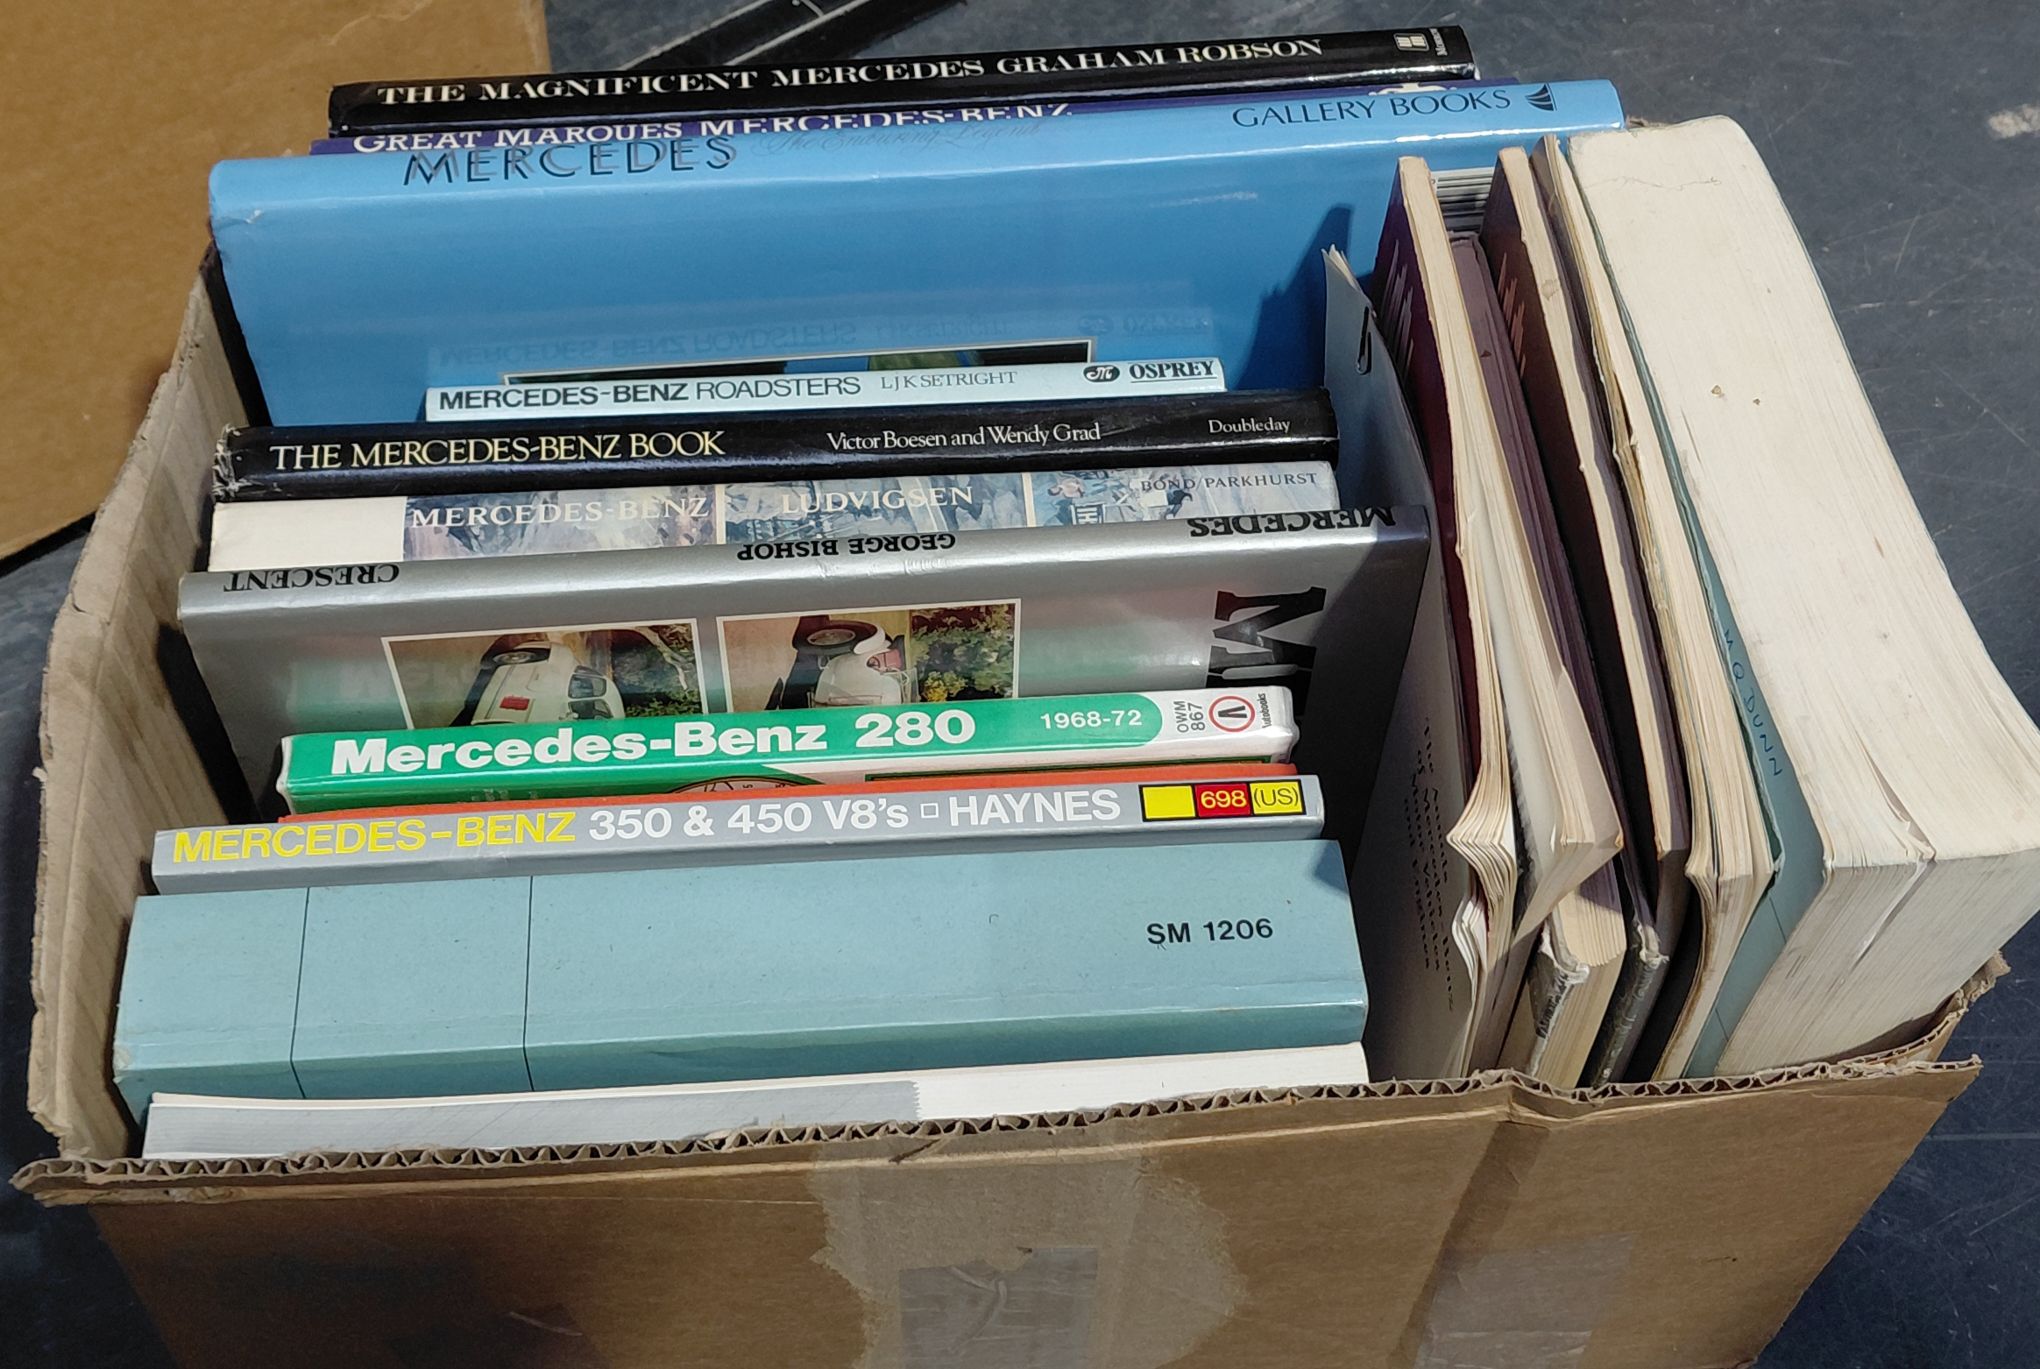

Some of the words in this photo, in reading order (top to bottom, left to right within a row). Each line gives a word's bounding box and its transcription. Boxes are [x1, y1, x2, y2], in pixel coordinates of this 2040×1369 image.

[377, 83, 466, 105] THE
[478, 70, 758, 100] MAGNIFICENT
[770, 58, 985, 88] MERCEDES
[996, 47, 1168, 75] GRAHAM
[1176, 38, 1325, 63] ROBSON
[1231, 99, 1377, 127] GALLERY
[1389, 89, 1511, 116] BOOKS
[353, 131, 482, 153] GREAT
[700, 103, 1073, 136] MERCEDES-BENZ
[403, 136, 737, 186] MERCEDES
[1129, 360, 1214, 380] OSPREY
[439, 382, 689, 410] MERCEDES-BENZ
[696, 376, 861, 401] ROADSTERS
[826, 431, 883, 450] Victor
[883, 429, 948, 449] Boesen
[950, 425, 986, 447] and
[985, 424, 1050, 451] Wendy
[1053, 422, 1101, 443] Grad
[1208, 416, 1291, 434] Doubleday
[270, 442, 343, 471] THE
[350, 433, 621, 469] MERCEDES-BENZ
[630, 430, 726, 460] BOOK
[410, 497, 712, 529] MERCEDES-BENZ
[782, 486, 973, 515] LUDVIGSEN
[1187, 505, 1396, 538] MERCEDES
[736, 539, 840, 561] BISHOP
[849, 532, 956, 555] GEORGE
[223, 563, 400, 593] CRESCENT
[1040, 709, 1143, 729] 1968-72
[1173, 700, 1190, 733] OWM
[1187, 701, 1206, 731] 867
[331, 720, 828, 775] Mercedes-Benz
[855, 709, 976, 748] 280
[1199, 789, 1248, 809] 698
[1253, 786, 1300, 808] (US)
[172, 811, 577, 864] MERCEDES-BENZ
[588, 807, 672, 841] 350
[683, 804, 715, 837] &
[727, 801, 813, 834] 450
[950, 789, 1121, 827] HAYNES
[1146, 922, 1192, 946] SM
[1203, 918, 1274, 942] 1206
